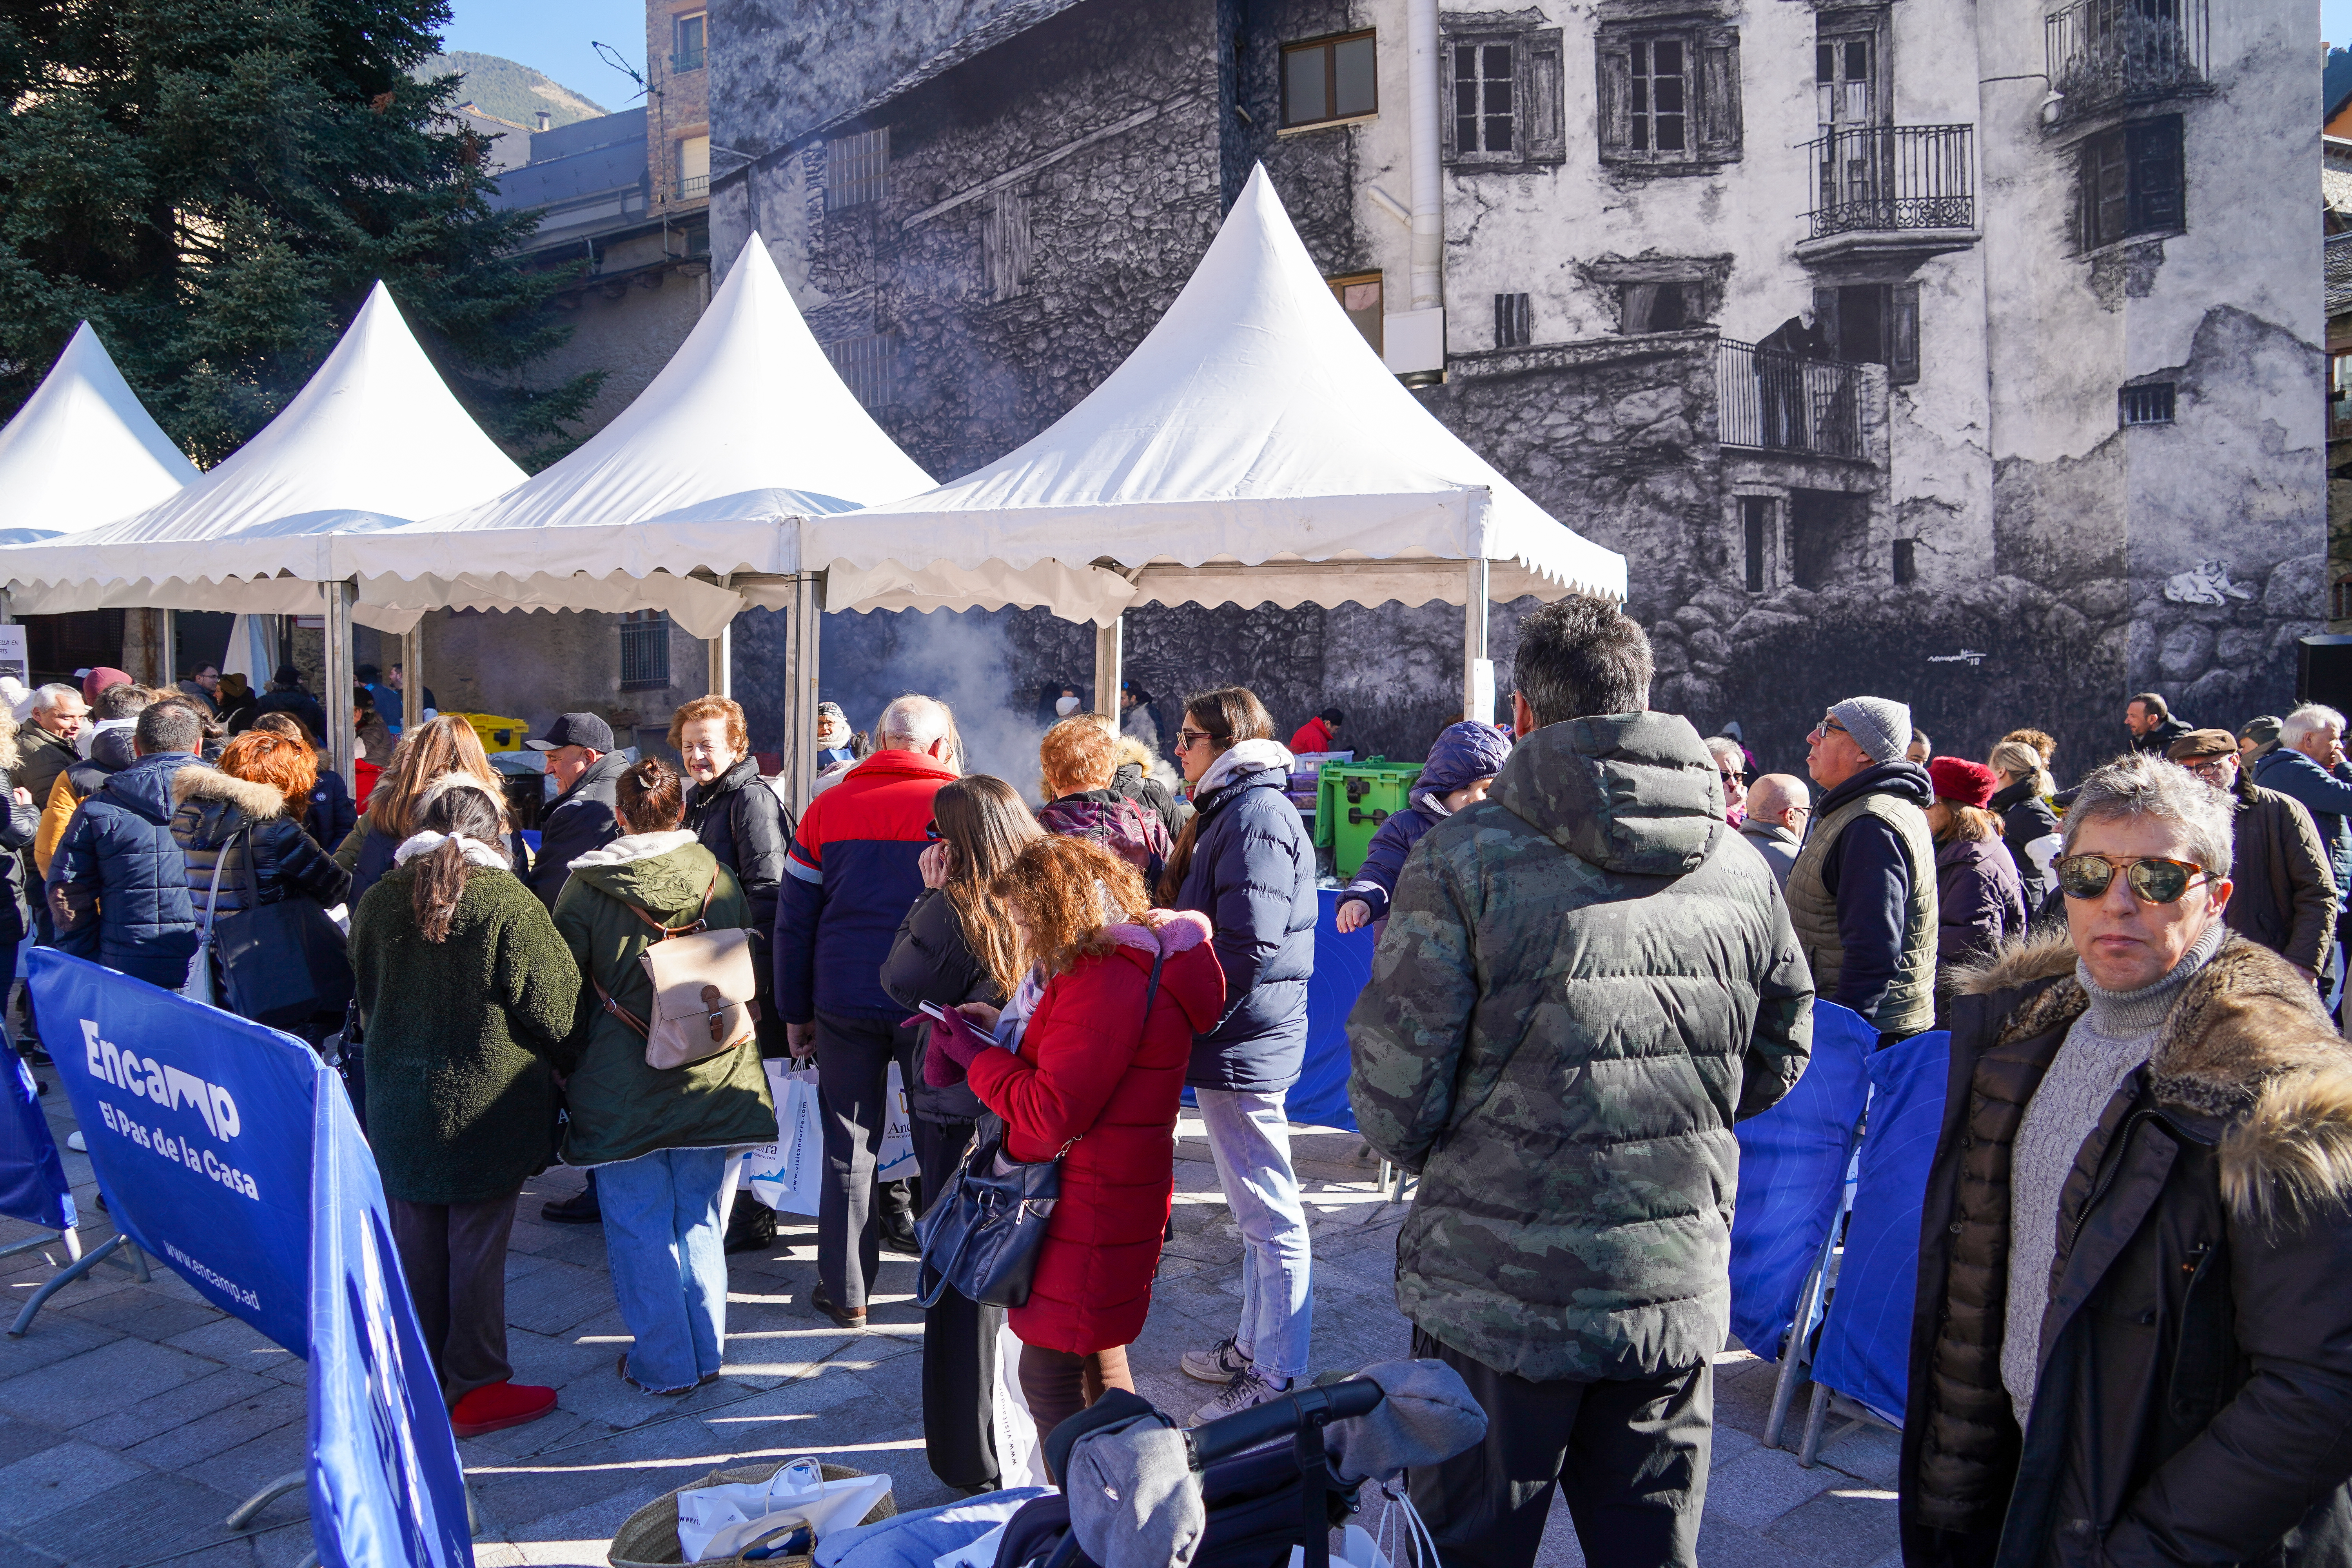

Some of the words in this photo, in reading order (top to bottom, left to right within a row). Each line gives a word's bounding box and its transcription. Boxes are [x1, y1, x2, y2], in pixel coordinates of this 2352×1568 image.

[79, 1018, 241, 1143] Encamp
[98, 1100, 119, 1132] El
[116, 1109, 151, 1149] Pas
[153, 1127, 180, 1162] de
[179, 1136, 203, 1174] la
[203, 1150, 260, 1201] Casa
[793, 1102, 807, 1191] www.visitandorra.com
[163, 1240, 261, 1311] www.encamp.ad
